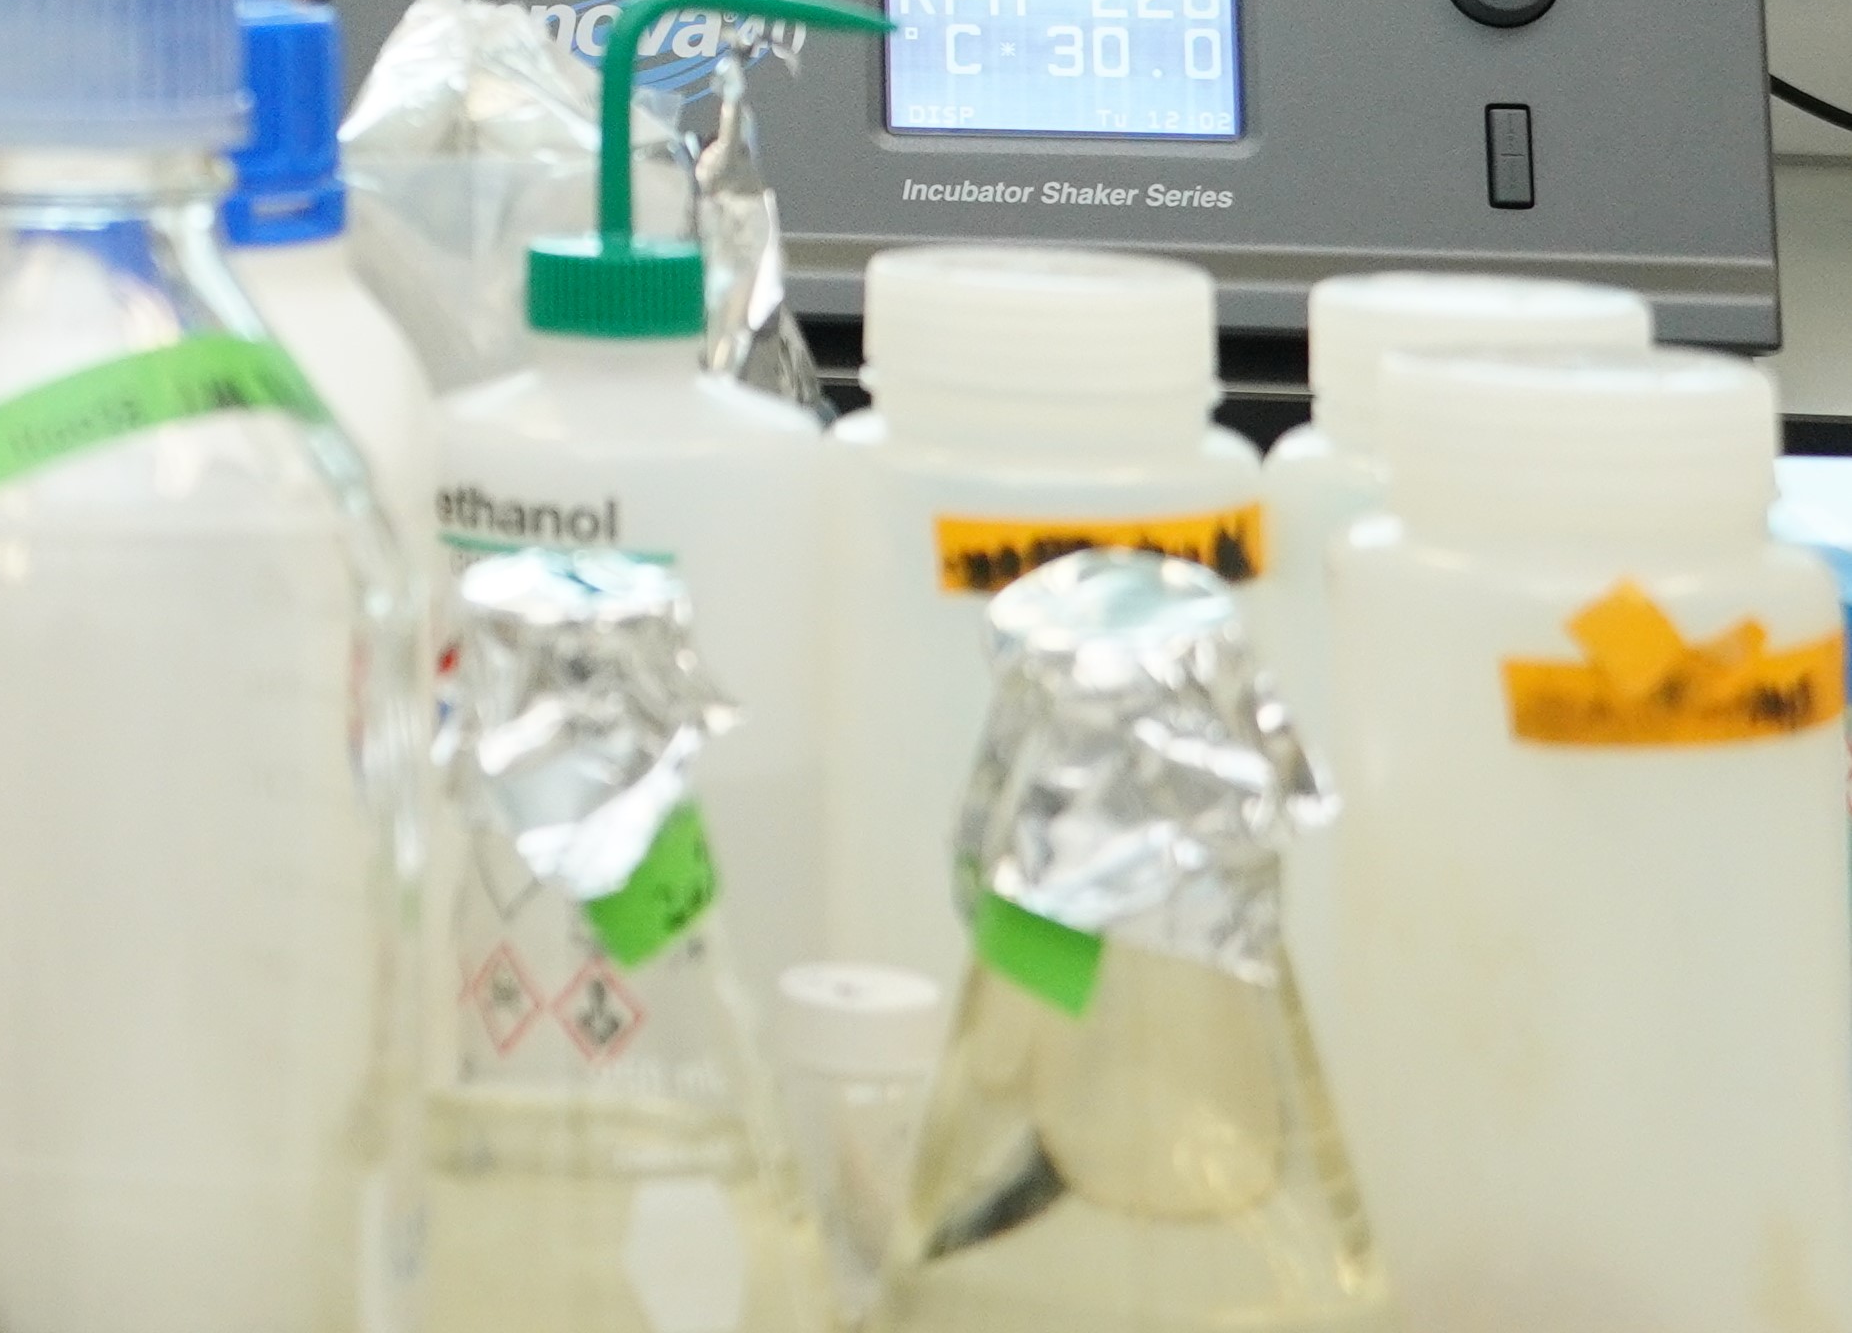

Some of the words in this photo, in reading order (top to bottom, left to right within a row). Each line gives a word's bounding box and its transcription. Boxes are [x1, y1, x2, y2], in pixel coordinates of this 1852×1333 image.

[1047, 25, 1223, 80] 30.0
[908, 104, 976, 126] DISP
[1147, 110, 1232, 132] 12:02
[901, 178, 1034, 204] Incubator
[1040, 181, 1139, 207] Shaker
[1145, 183, 1234, 209] Series
